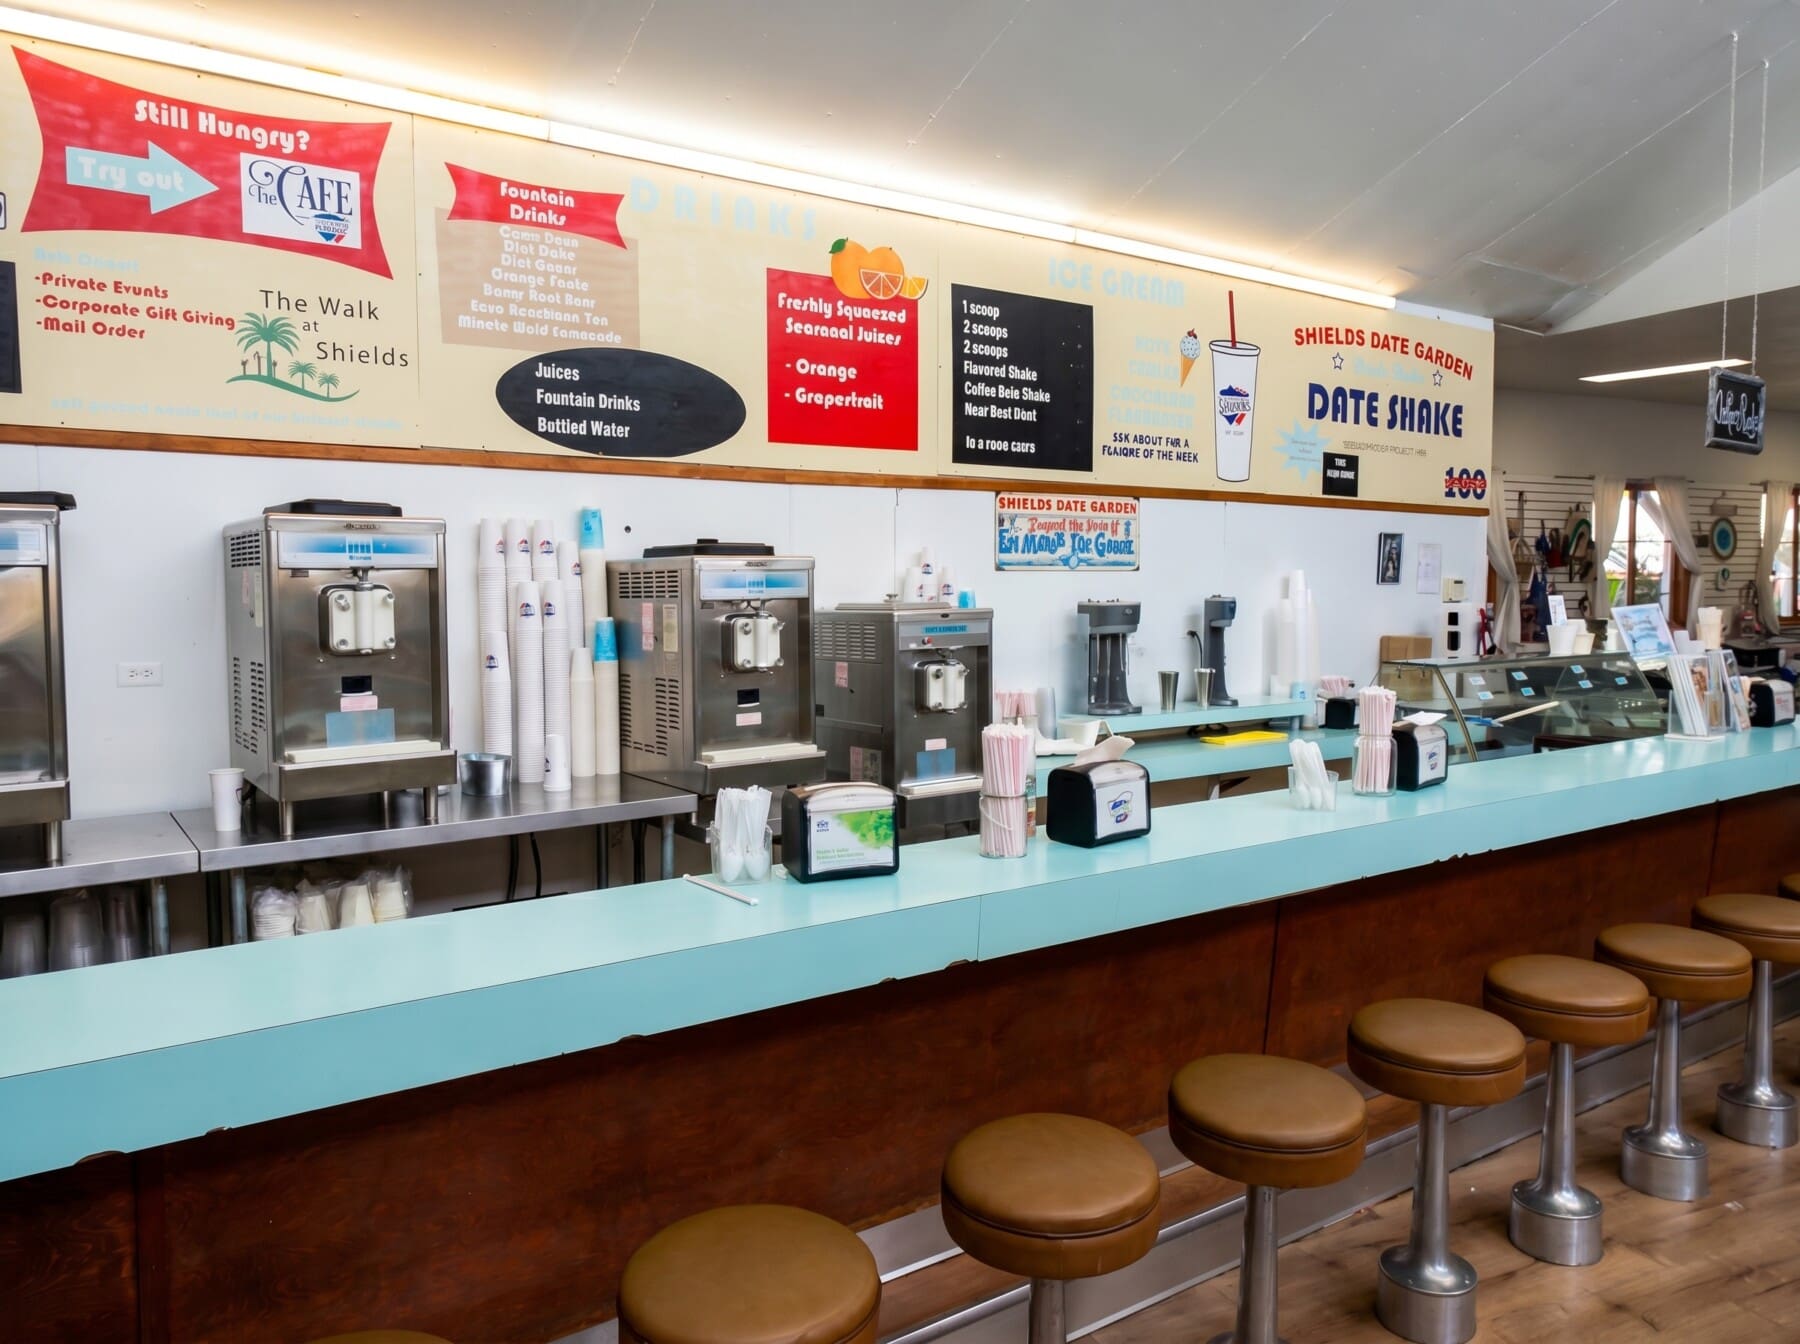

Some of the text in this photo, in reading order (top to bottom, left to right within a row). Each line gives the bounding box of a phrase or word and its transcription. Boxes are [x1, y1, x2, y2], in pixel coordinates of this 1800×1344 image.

[134, 98, 311, 153] Still Hungry?
[77, 155, 185, 193] Try out
[499, 181, 576, 209] Fountain
[510, 204, 567, 227] Drinks
[491, 267, 546, 289] Orange
[259, 289, 381, 321] The Walk
[778, 292, 833, 319] Freshly
[962, 300, 1000, 322] 1 scoop
[146, 304, 178, 323] Gift
[183, 309, 236, 332] Giving
[302, 318, 320, 334] at
[963, 320, 971, 334] 2
[92, 321, 147, 341] Order
[316, 341, 410, 368] Shields
[963, 339, 1009, 360] 2 scoops
[1294, 327, 1365, 347] SHIELDS
[1370, 331, 1410, 355] DATE
[1414, 341, 1474, 381] GARDEN
[535, 362, 580, 381] Juices
[796, 358, 857, 383] Orange
[963, 360, 1038, 382] Flavored Shake
[536, 388, 641, 412] Fountain Drinks
[964, 381, 997, 398] Coffee
[1022, 387, 1051, 403] Shake
[964, 402, 989, 418] Near
[990, 404, 1012, 420] Best
[1308, 382, 1464, 438] DATE SHAKE
[591, 421, 630, 438] Water
[1132, 434, 1163, 446] ABOUT
[1184, 438, 1190, 449] A
[1143, 448, 1154, 459] OF
[1157, 450, 1174, 461] THE
[998, 497, 1137, 515] SHIELDS DATE GARDEN
